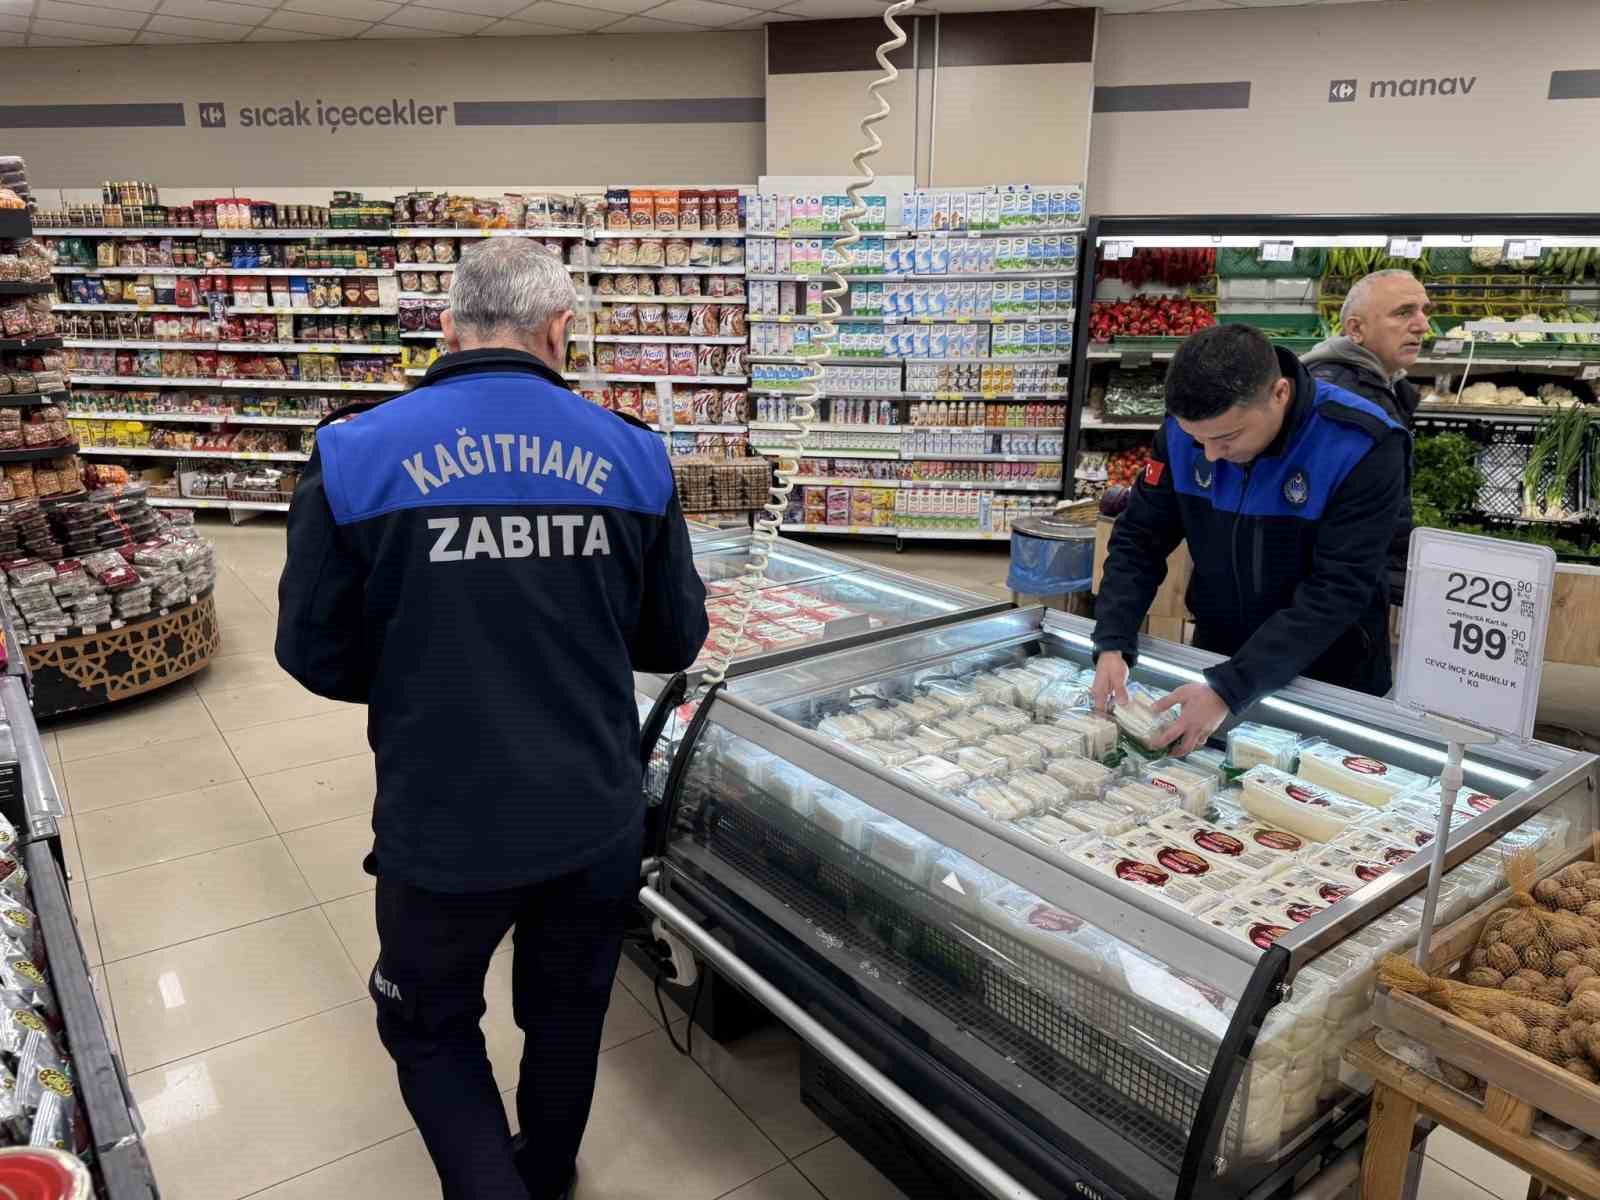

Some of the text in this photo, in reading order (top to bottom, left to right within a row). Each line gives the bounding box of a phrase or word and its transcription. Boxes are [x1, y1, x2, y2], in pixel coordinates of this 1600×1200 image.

[1369, 76, 1477, 98] manav
[239, 98, 448, 134] sıcak içecekler
[401, 427, 613, 496] KAĞITHANE
[427, 514, 611, 562] ZABITA
[1445, 572, 1512, 613] 229
[1448, 620, 1507, 661] 199
[1468, 669, 1508, 686] KABUKLU
